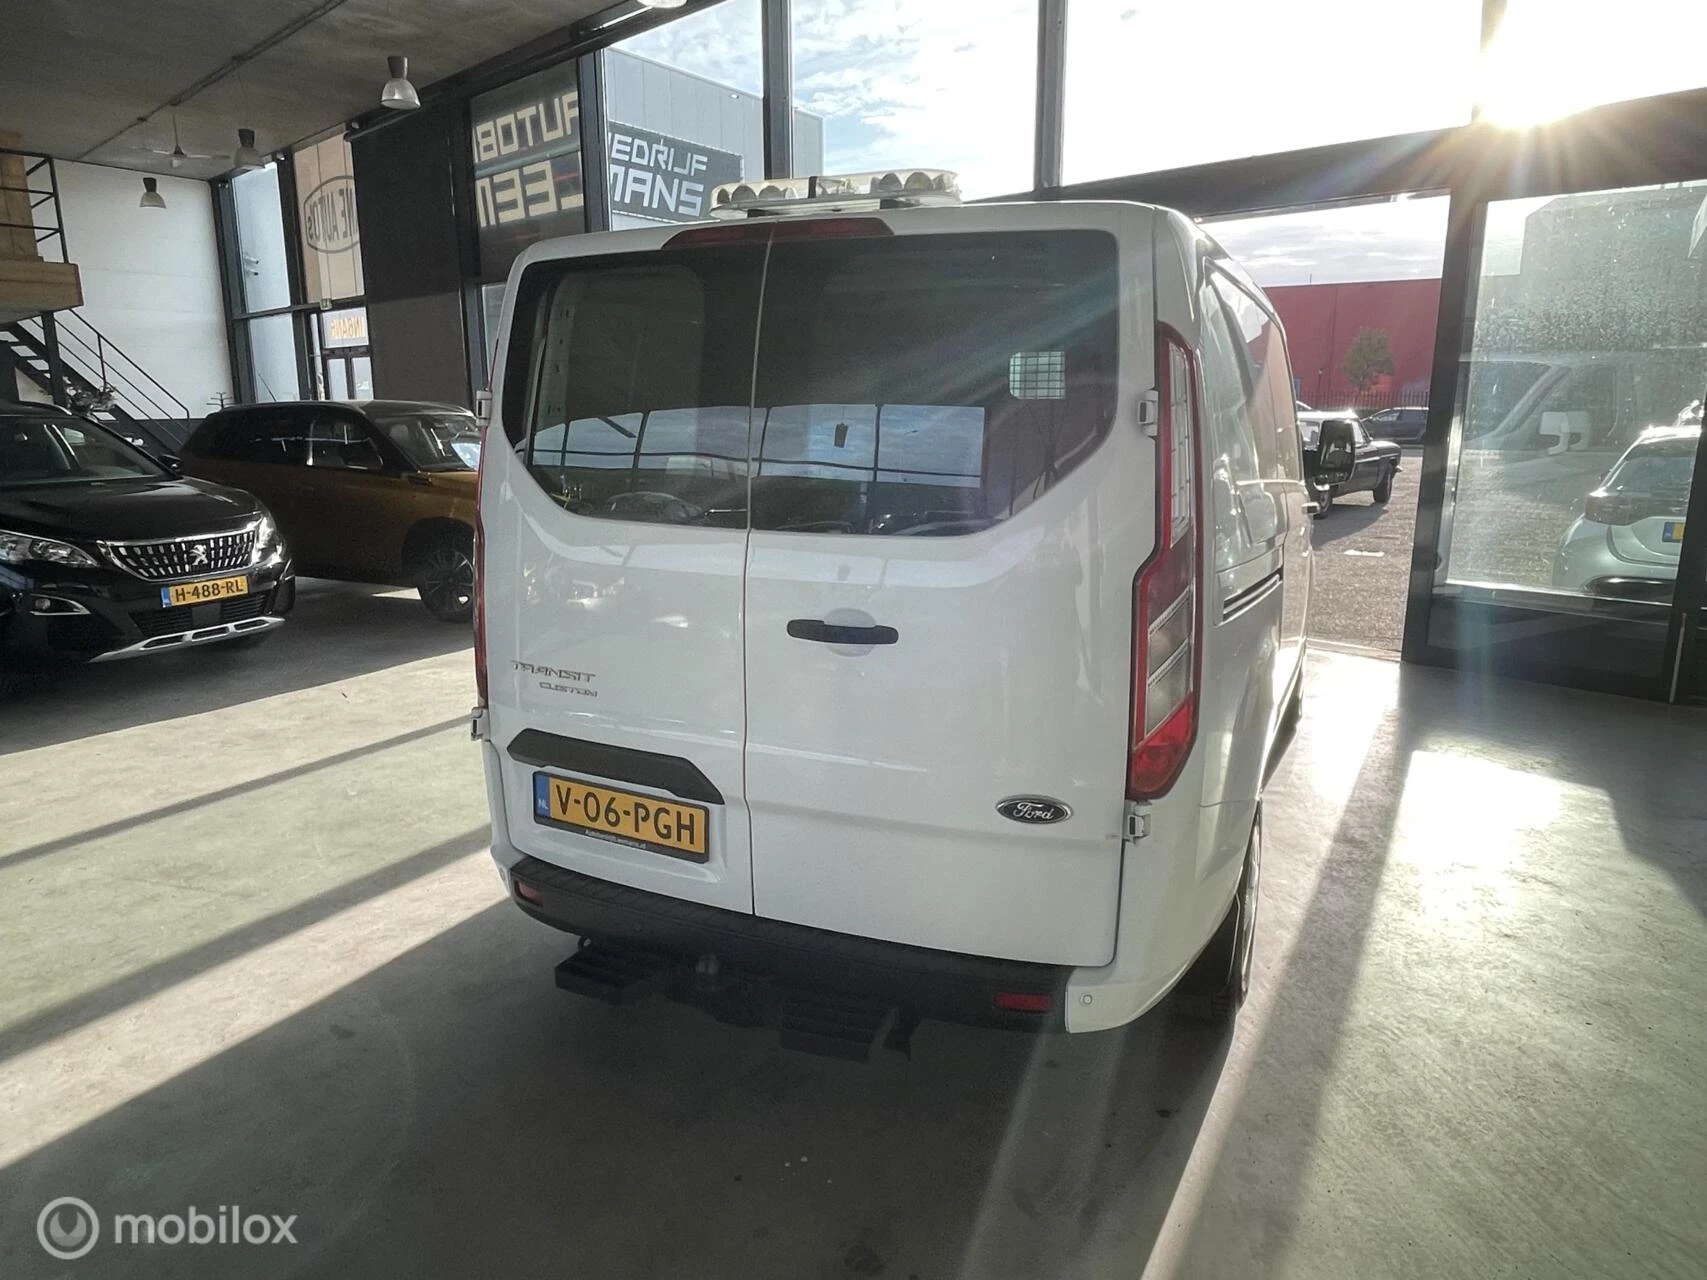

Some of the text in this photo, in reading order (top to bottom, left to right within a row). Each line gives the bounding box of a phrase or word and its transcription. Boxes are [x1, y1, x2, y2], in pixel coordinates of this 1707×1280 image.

[609, 132, 708, 177] EDRIJF
[175, 579, 244, 603] H-488-RL
[510, 659, 596, 683] TRANSIT
[539, 681, 598, 698] CUSTOM
[556, 785, 695, 845] V-06-PGH
[1013, 802, 1055, 820] Ford
